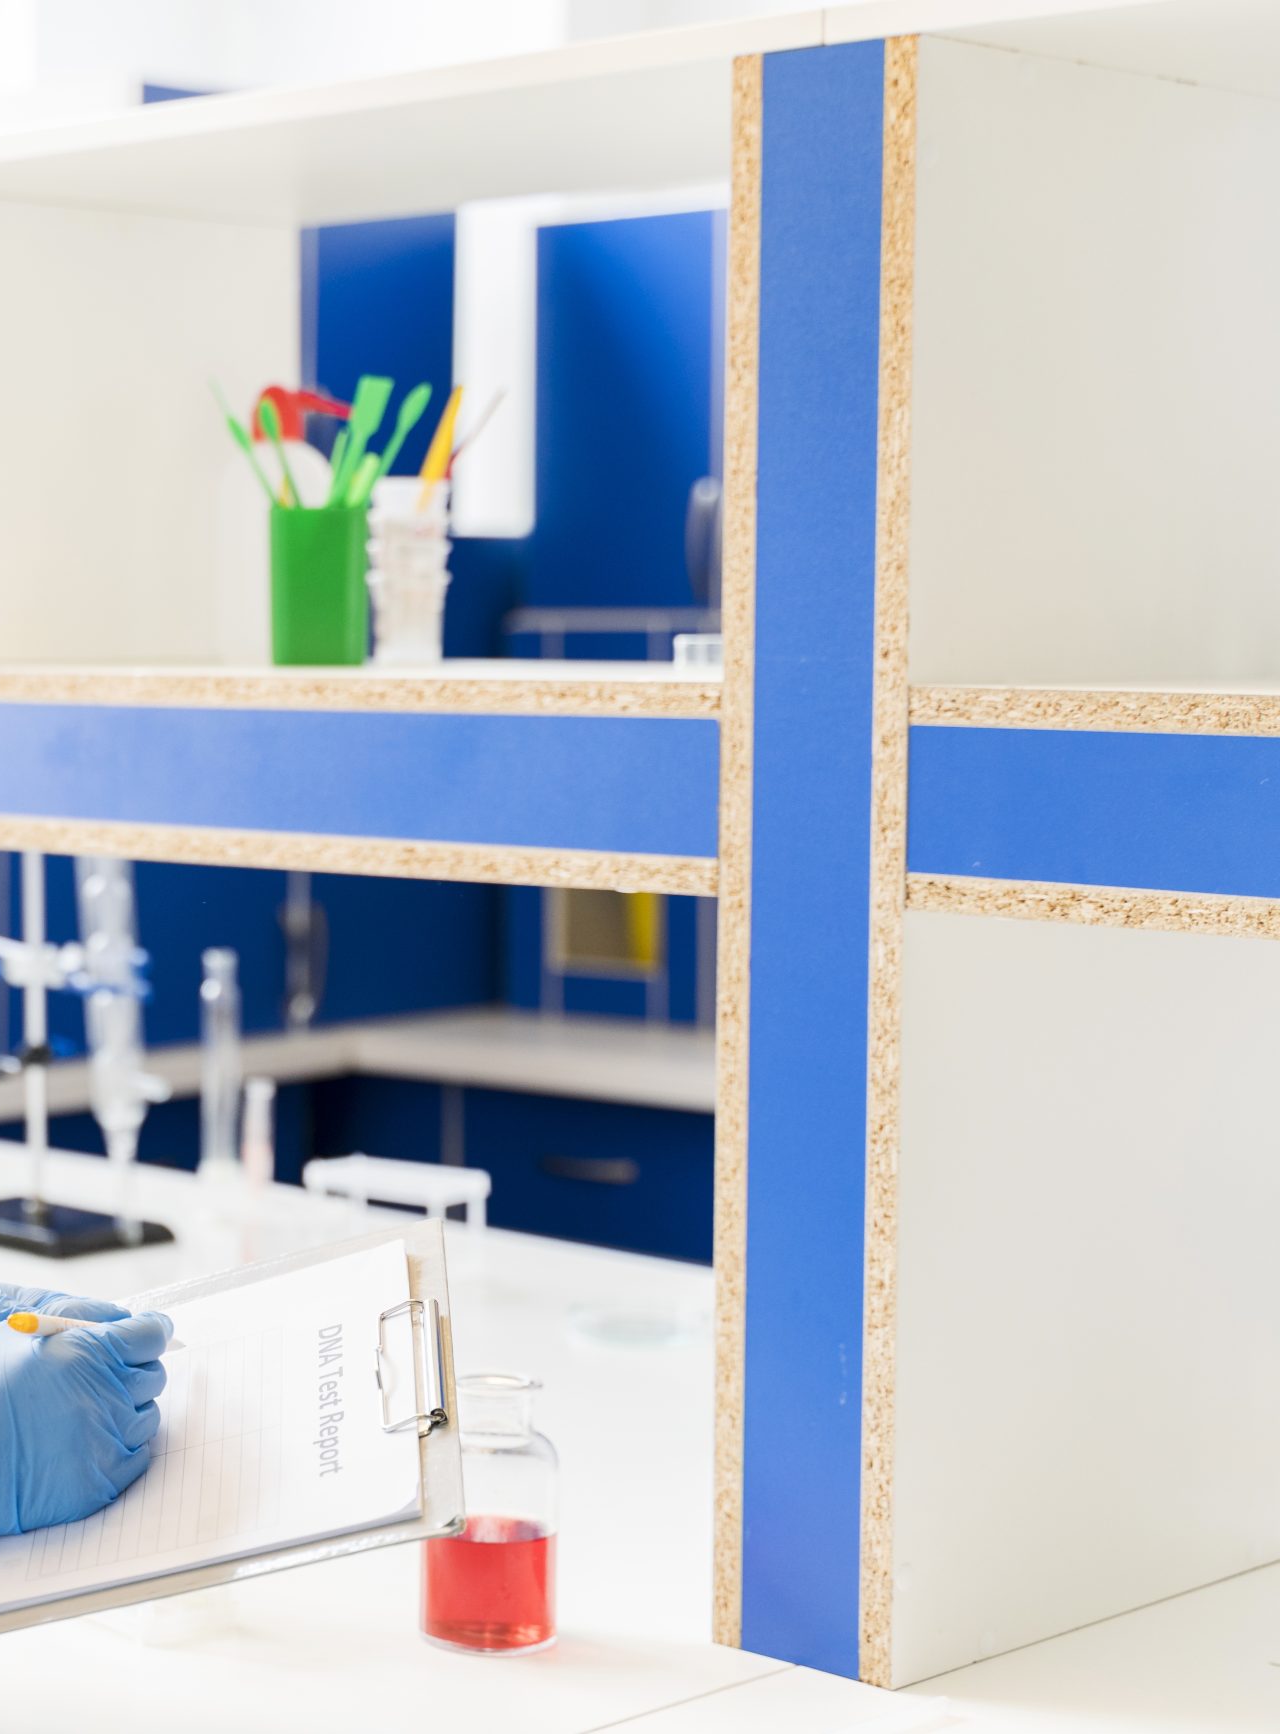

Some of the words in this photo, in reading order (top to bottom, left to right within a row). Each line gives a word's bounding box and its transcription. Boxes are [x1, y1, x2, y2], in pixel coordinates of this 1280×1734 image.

[318, 1323, 343, 1368] DNA
[318, 1366, 344, 1410] Test
[312, 1410, 345, 1478] Report
